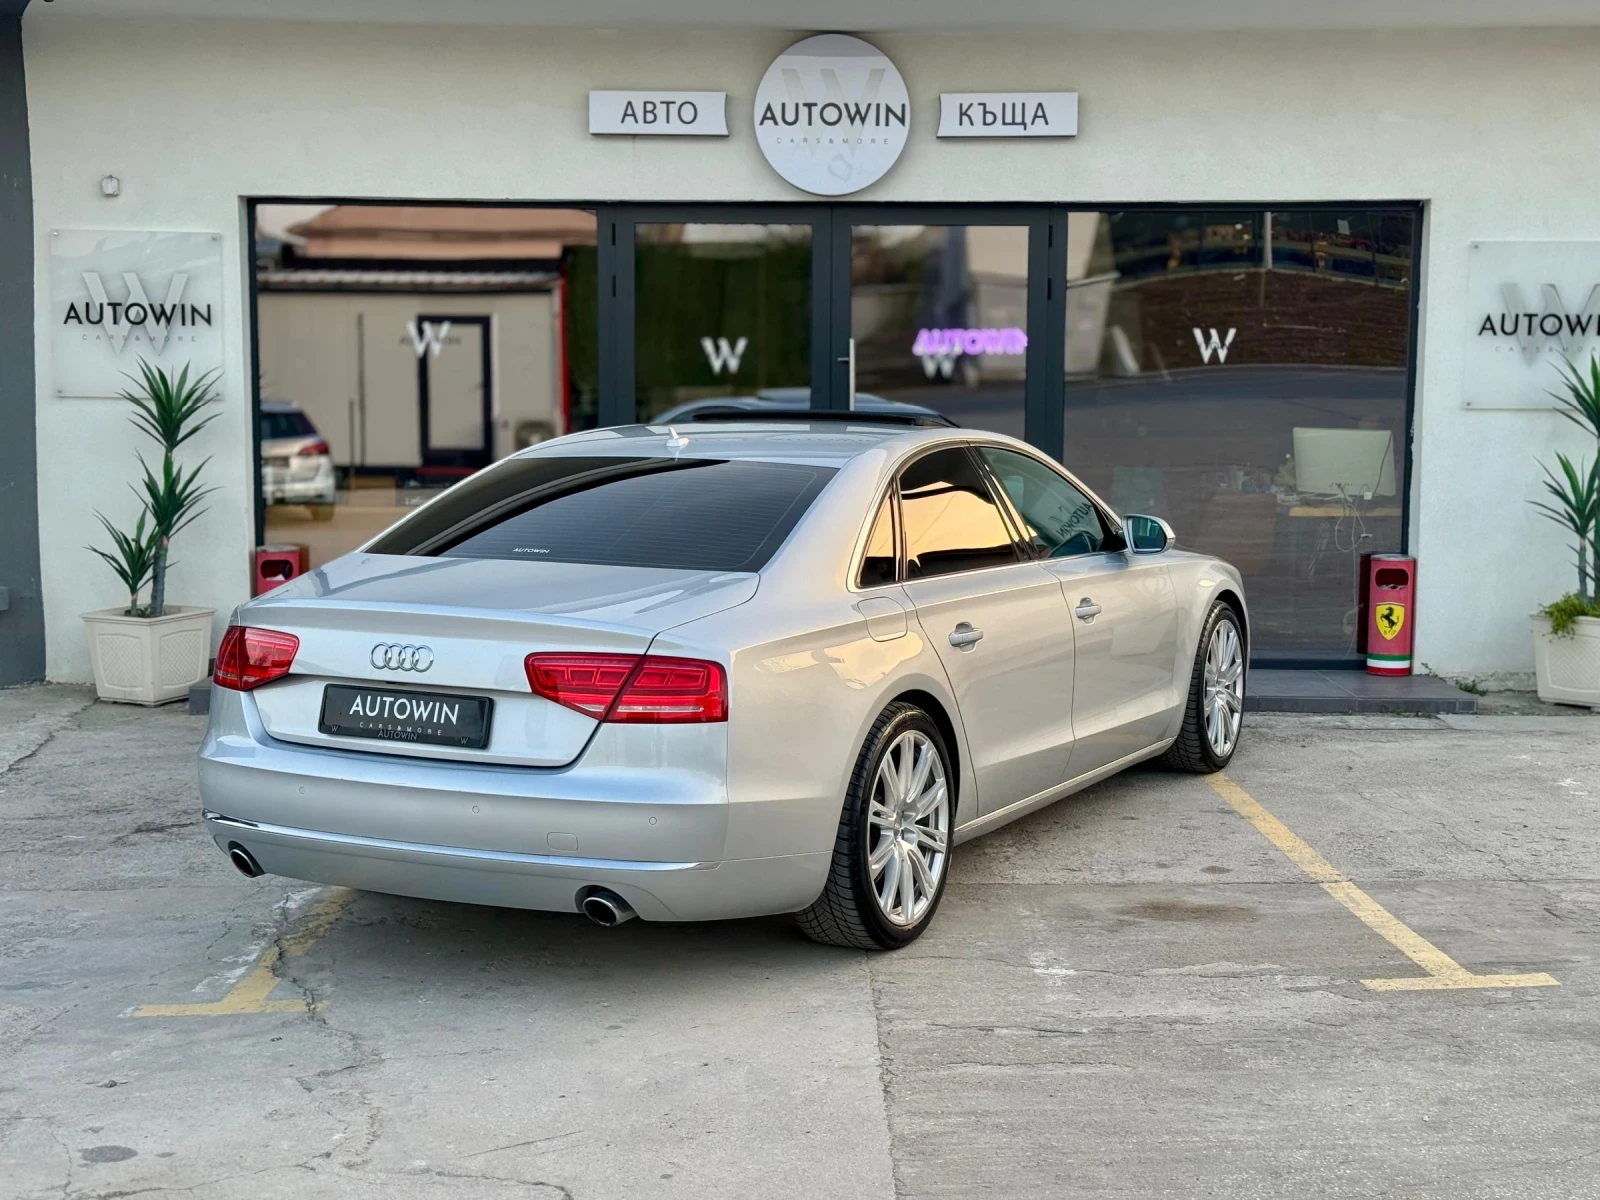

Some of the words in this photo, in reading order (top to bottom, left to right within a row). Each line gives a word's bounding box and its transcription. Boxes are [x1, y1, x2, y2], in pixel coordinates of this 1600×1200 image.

[619, 99, 699, 125] АВТО
[758, 102, 907, 127] AUTOWIN
[957, 101, 1050, 130] КЪЩА
[62, 301, 213, 327] AUTOWIN
[405, 320, 452, 359] W
[1192, 327, 1238, 365] W
[702, 337, 749, 375] W
[349, 694, 460, 726] AUTOWIN
[378, 730, 418, 741] AUTOWIN
